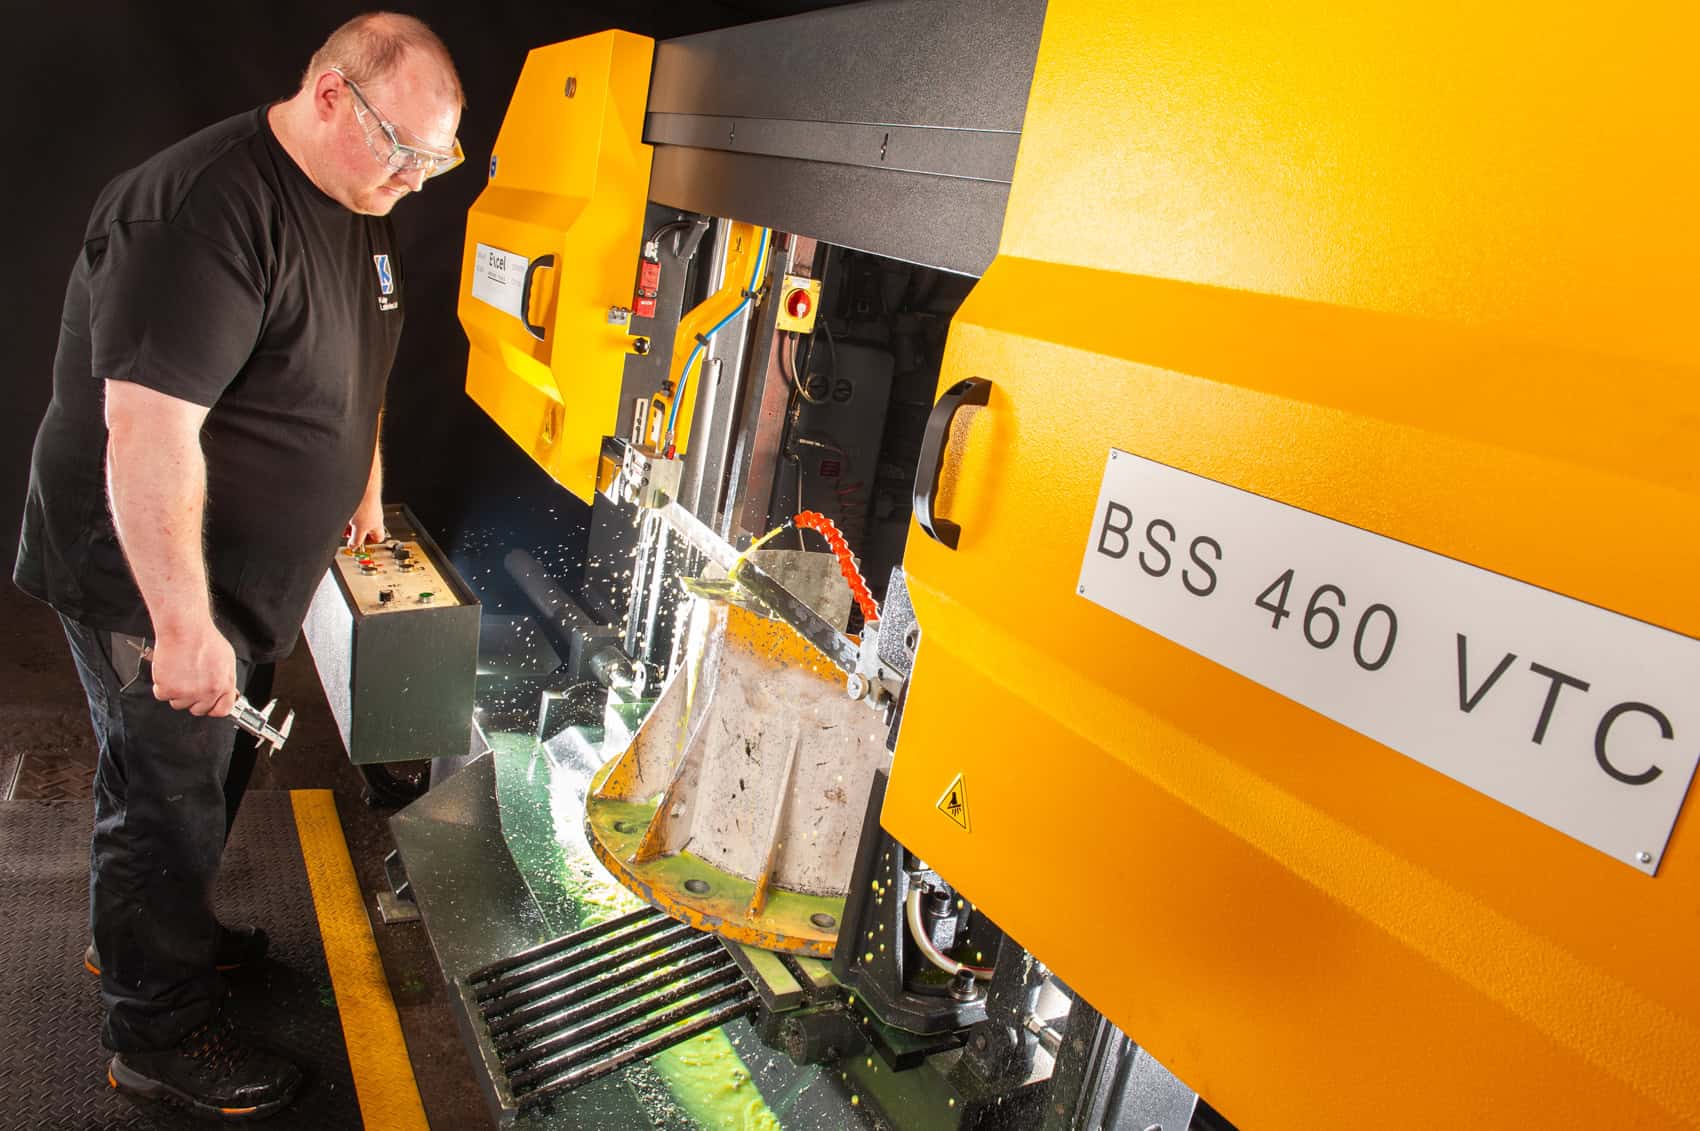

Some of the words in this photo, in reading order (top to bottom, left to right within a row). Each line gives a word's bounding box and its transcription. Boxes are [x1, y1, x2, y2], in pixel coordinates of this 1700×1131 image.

[1097, 500, 1223, 597] BSS
[1254, 568, 1399, 672] 460
[1456, 632, 1675, 786] VTC
